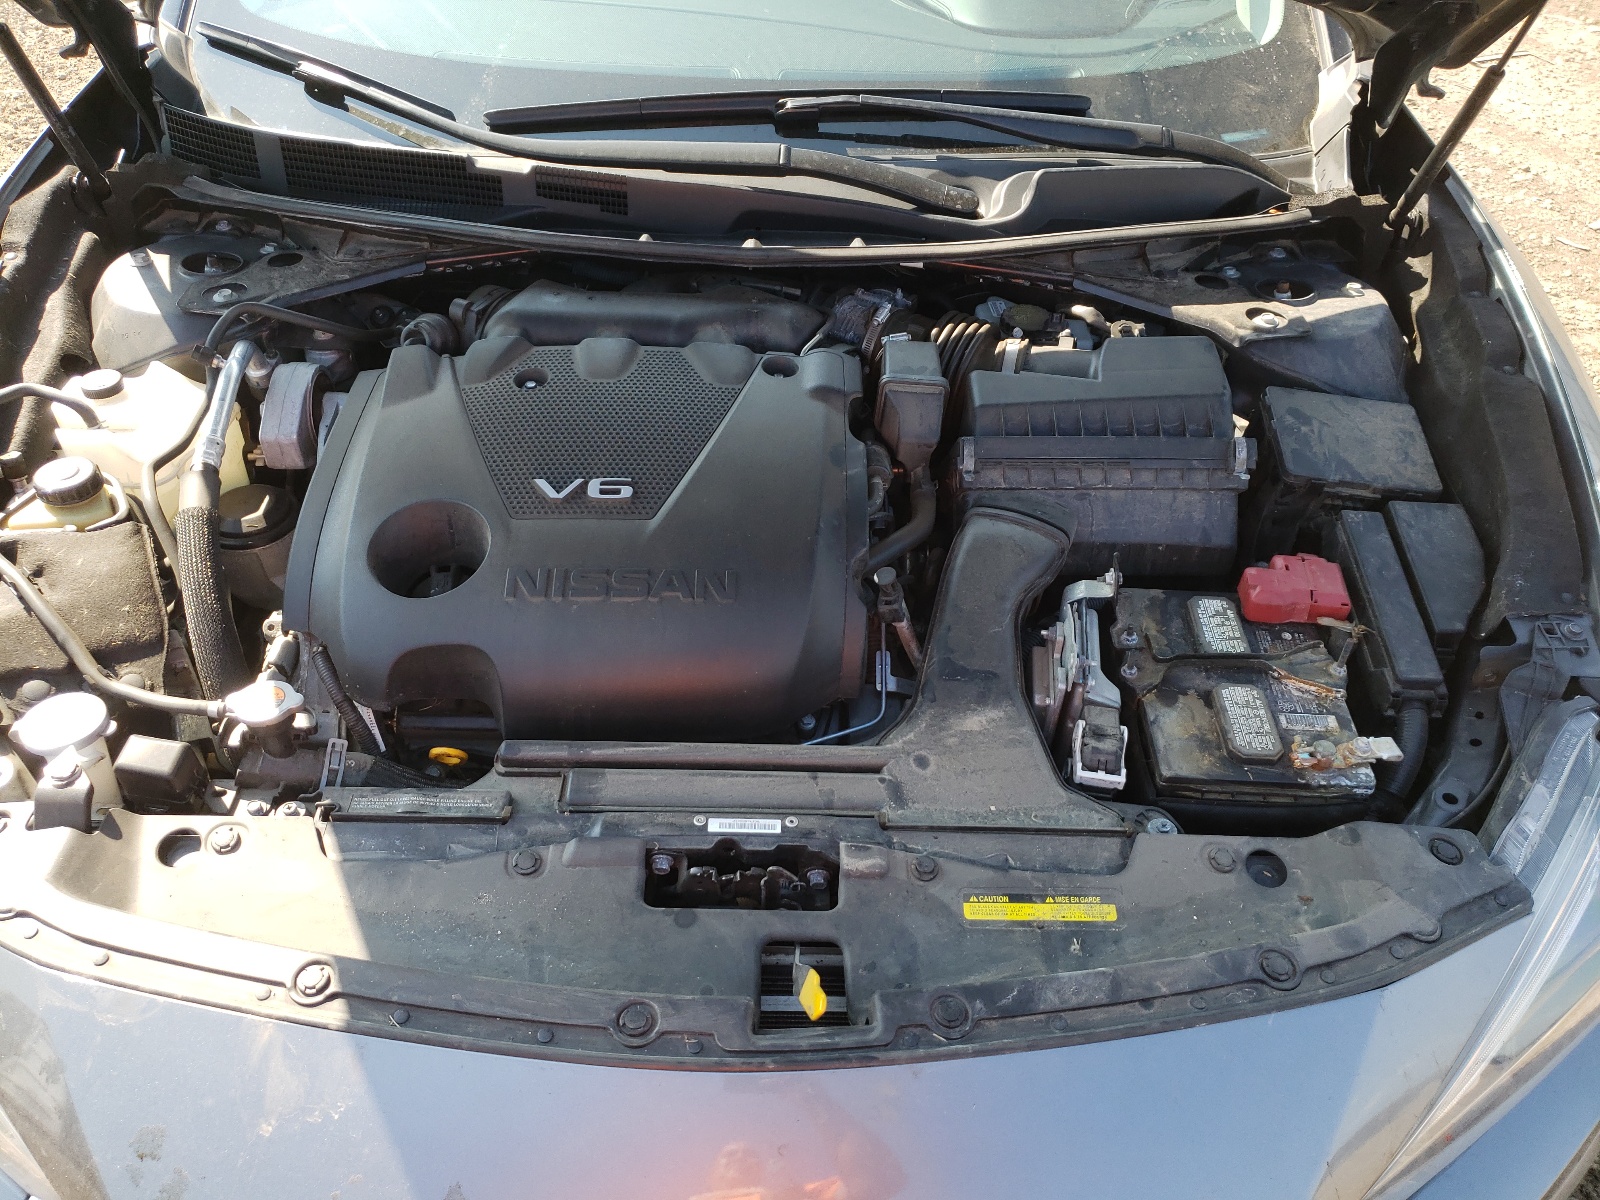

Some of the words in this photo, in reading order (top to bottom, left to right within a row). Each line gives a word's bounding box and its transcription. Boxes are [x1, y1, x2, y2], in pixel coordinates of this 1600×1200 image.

[533, 477, 634, 501] V6
[504, 567, 737, 603] NISSAN
[978, 895, 1009, 903] CAUTION
